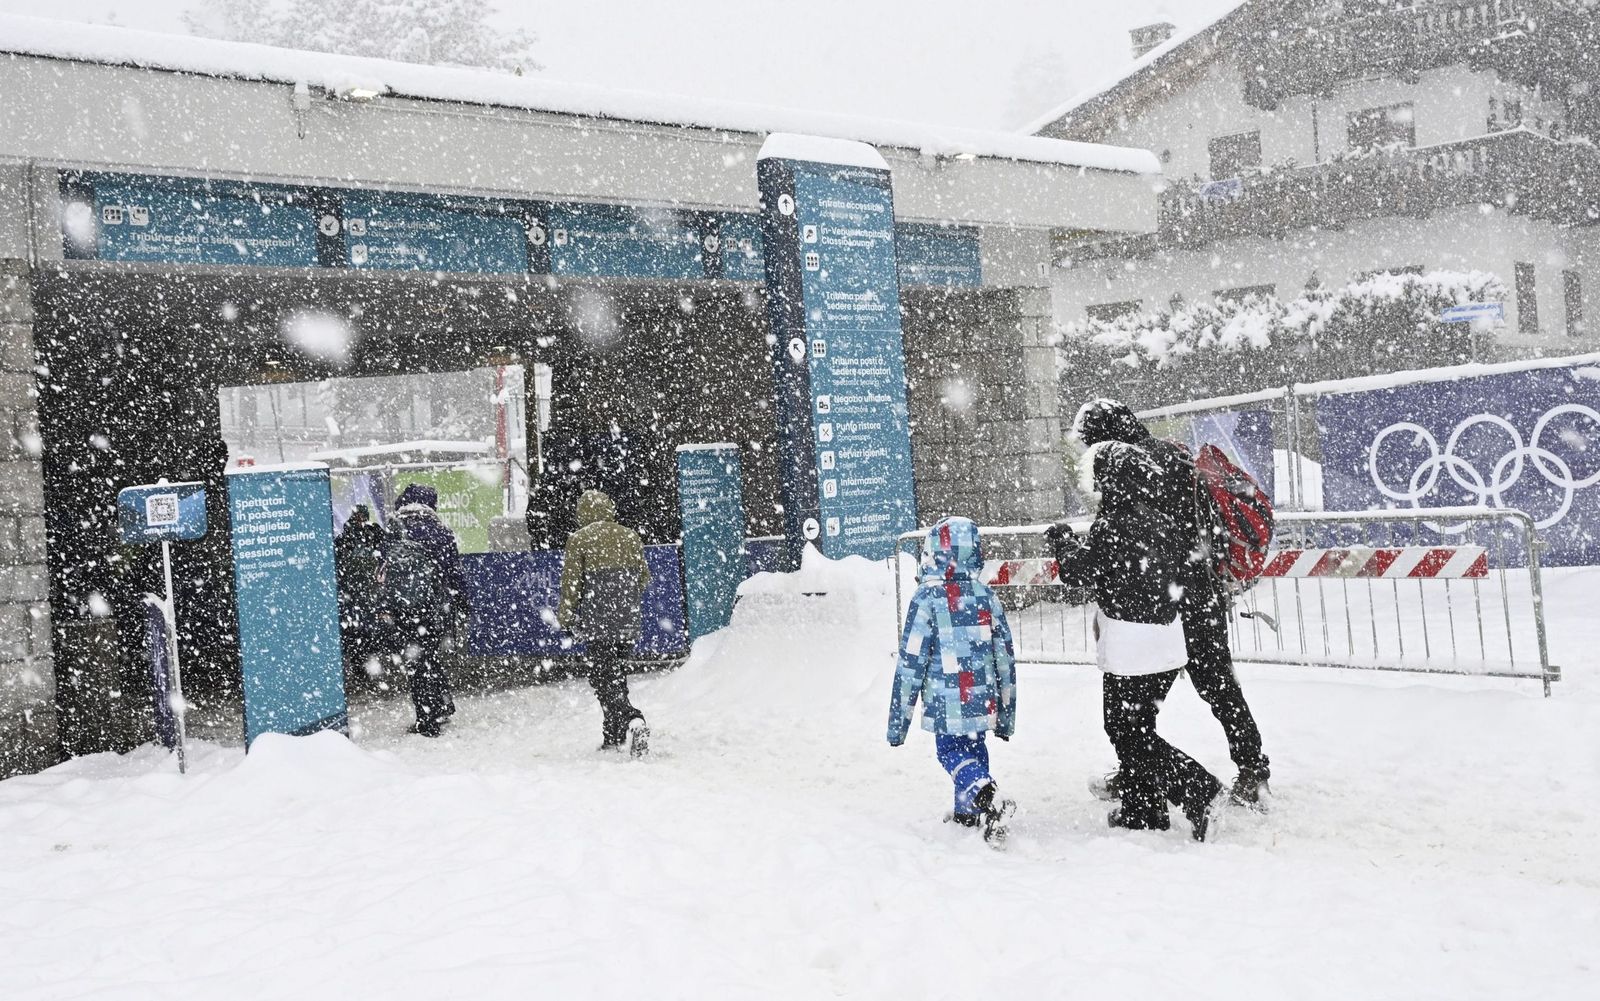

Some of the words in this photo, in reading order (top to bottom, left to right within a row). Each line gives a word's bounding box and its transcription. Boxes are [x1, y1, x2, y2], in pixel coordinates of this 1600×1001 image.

[818, 199, 845, 209] Entrata
[130, 232, 174, 243] Tribuna
[175, 234, 199, 245] posti
[202, 236, 208, 244] a
[211, 236, 245, 246] sedere
[248, 238, 294, 249] spettatori
[827, 302, 851, 310] sedere
[834, 395, 862, 405] Negozio
[864, 394, 892, 402] ufficiale
[859, 422, 881, 430] ristoro
[840, 477, 885, 487] Informazioni
[235, 496, 286, 510] Spettatori
[248, 508, 295, 521] possesso
[843, 515, 861, 525] Area
[237, 523, 247, 533] di
[249, 521, 291, 535] biglietto
[845, 525, 879, 536] spettatori
[238, 537, 255, 548] per
[269, 530, 316, 546] prossima
[240, 547, 283, 559] sessione
